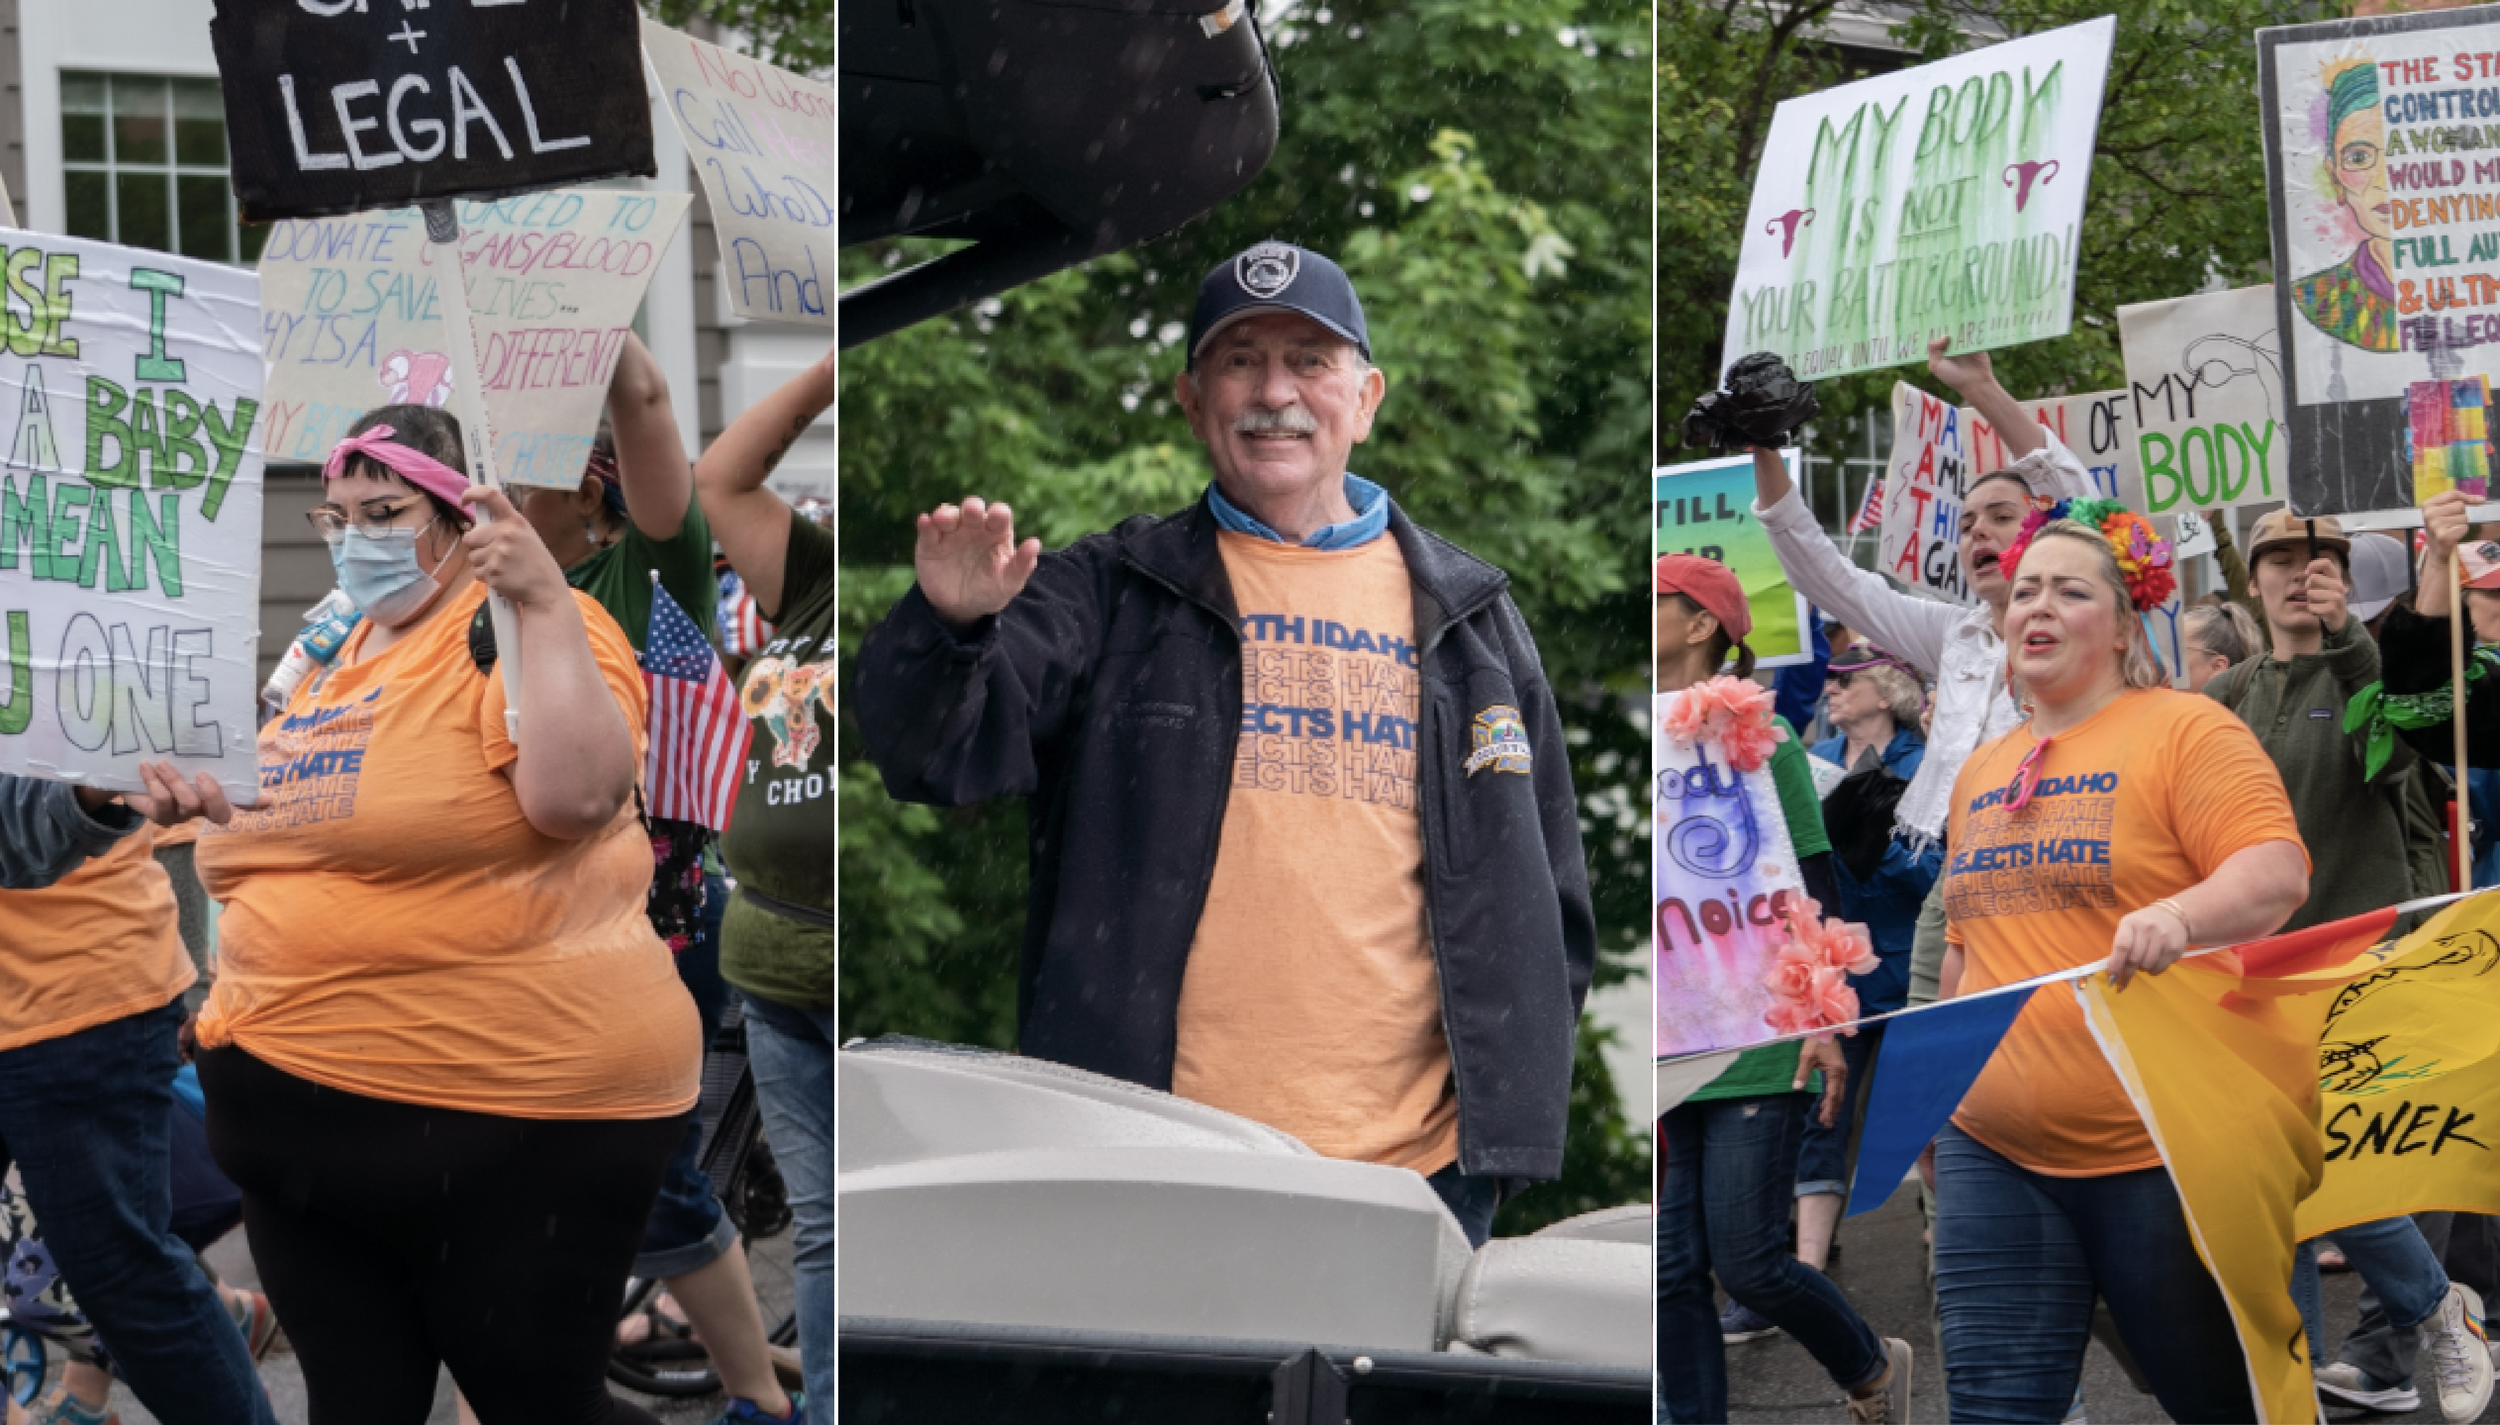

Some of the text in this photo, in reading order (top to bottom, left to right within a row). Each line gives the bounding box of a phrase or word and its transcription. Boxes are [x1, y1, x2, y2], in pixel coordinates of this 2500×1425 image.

[690, 41, 757, 99] No
[2380, 51, 2500, 86] THE ST
[277, 56, 591, 170] LEGAL
[676, 88, 763, 157] Call
[1807, 59, 2063, 185] MY BODY
[2387, 158, 2467, 191] WOULD
[266, 219, 408, 262] DONATE
[461, 193, 656, 232] ORCED TO
[1842, 176, 1978, 251] IS NOT
[2390, 193, 2500, 230] DENYIN
[732, 237, 826, 316] And
[2393, 231, 2500, 270] FULL AU
[0, 245, 187, 383] SE I
[305, 267, 347, 314] TO
[351, 269, 443, 322] SAVE
[1739, 224, 2074, 346] YOUR BATTLEGROUND!
[2398, 278, 2424, 315] &
[481, 327, 631, 391] DIFFERENT
[1802, 346, 1845, 375] EQUAL
[1851, 338, 1889, 366] UNTIL
[1897, 330, 1920, 359] WE
[2088, 394, 2128, 454] OF
[2132, 372, 2202, 428] MY
[7, 363, 259, 523] A BABY
[2139, 419, 2275, 513] BODY
[0, 473, 184, 598] MEAN
[56, 611, 224, 759] ONE
[1241, 702, 1336, 738] ECTS
[1342, 710, 1419, 750] HAT
[1657, 742, 1760, 880] ody
[2034, 771, 2119, 798] IDAHO
[2038, 838, 2110, 864] HATE
[2324, 1100, 2491, 1162] SNEK
